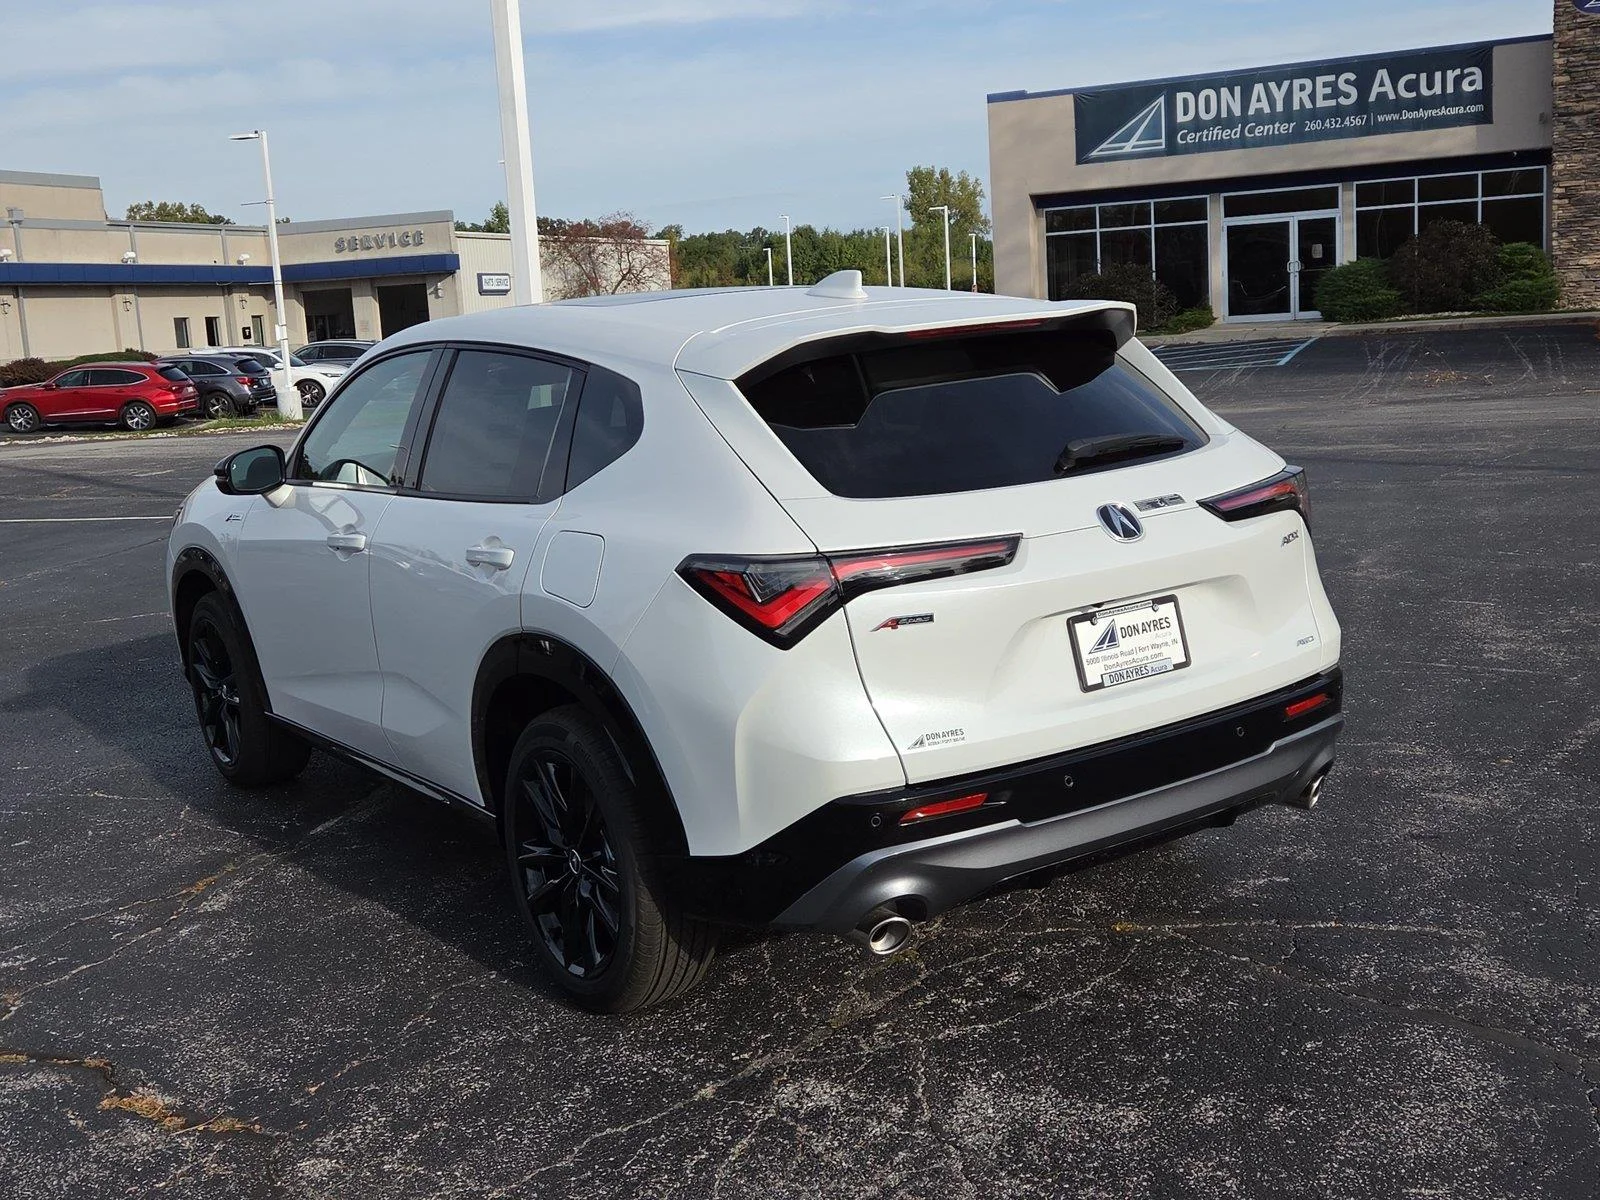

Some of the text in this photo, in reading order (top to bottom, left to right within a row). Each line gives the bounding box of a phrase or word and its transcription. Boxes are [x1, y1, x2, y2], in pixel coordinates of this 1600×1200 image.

[1176, 66, 1483, 123] DON AYRES Acura
[1177, 104, 1484, 144] Certified Center 260.432.4567 www.DonAyresAcura.com
[335, 229, 424, 254] SERVICE
[1120, 616, 1171, 639] DON AYRES
[1086, 657, 1101, 666] 5000
[1101, 652, 1119, 662] Illinois
[1120, 648, 1135, 657] Road
[1138, 645, 1150, 653] Fort
[1150, 641, 1171, 650] Wayne,
[1104, 652, 1164, 671] DonAyresAcura.com
[1109, 664, 1168, 684] DON AYRES Acura
[925, 732, 941, 741] DON
[941, 728, 965, 739] AYRES
